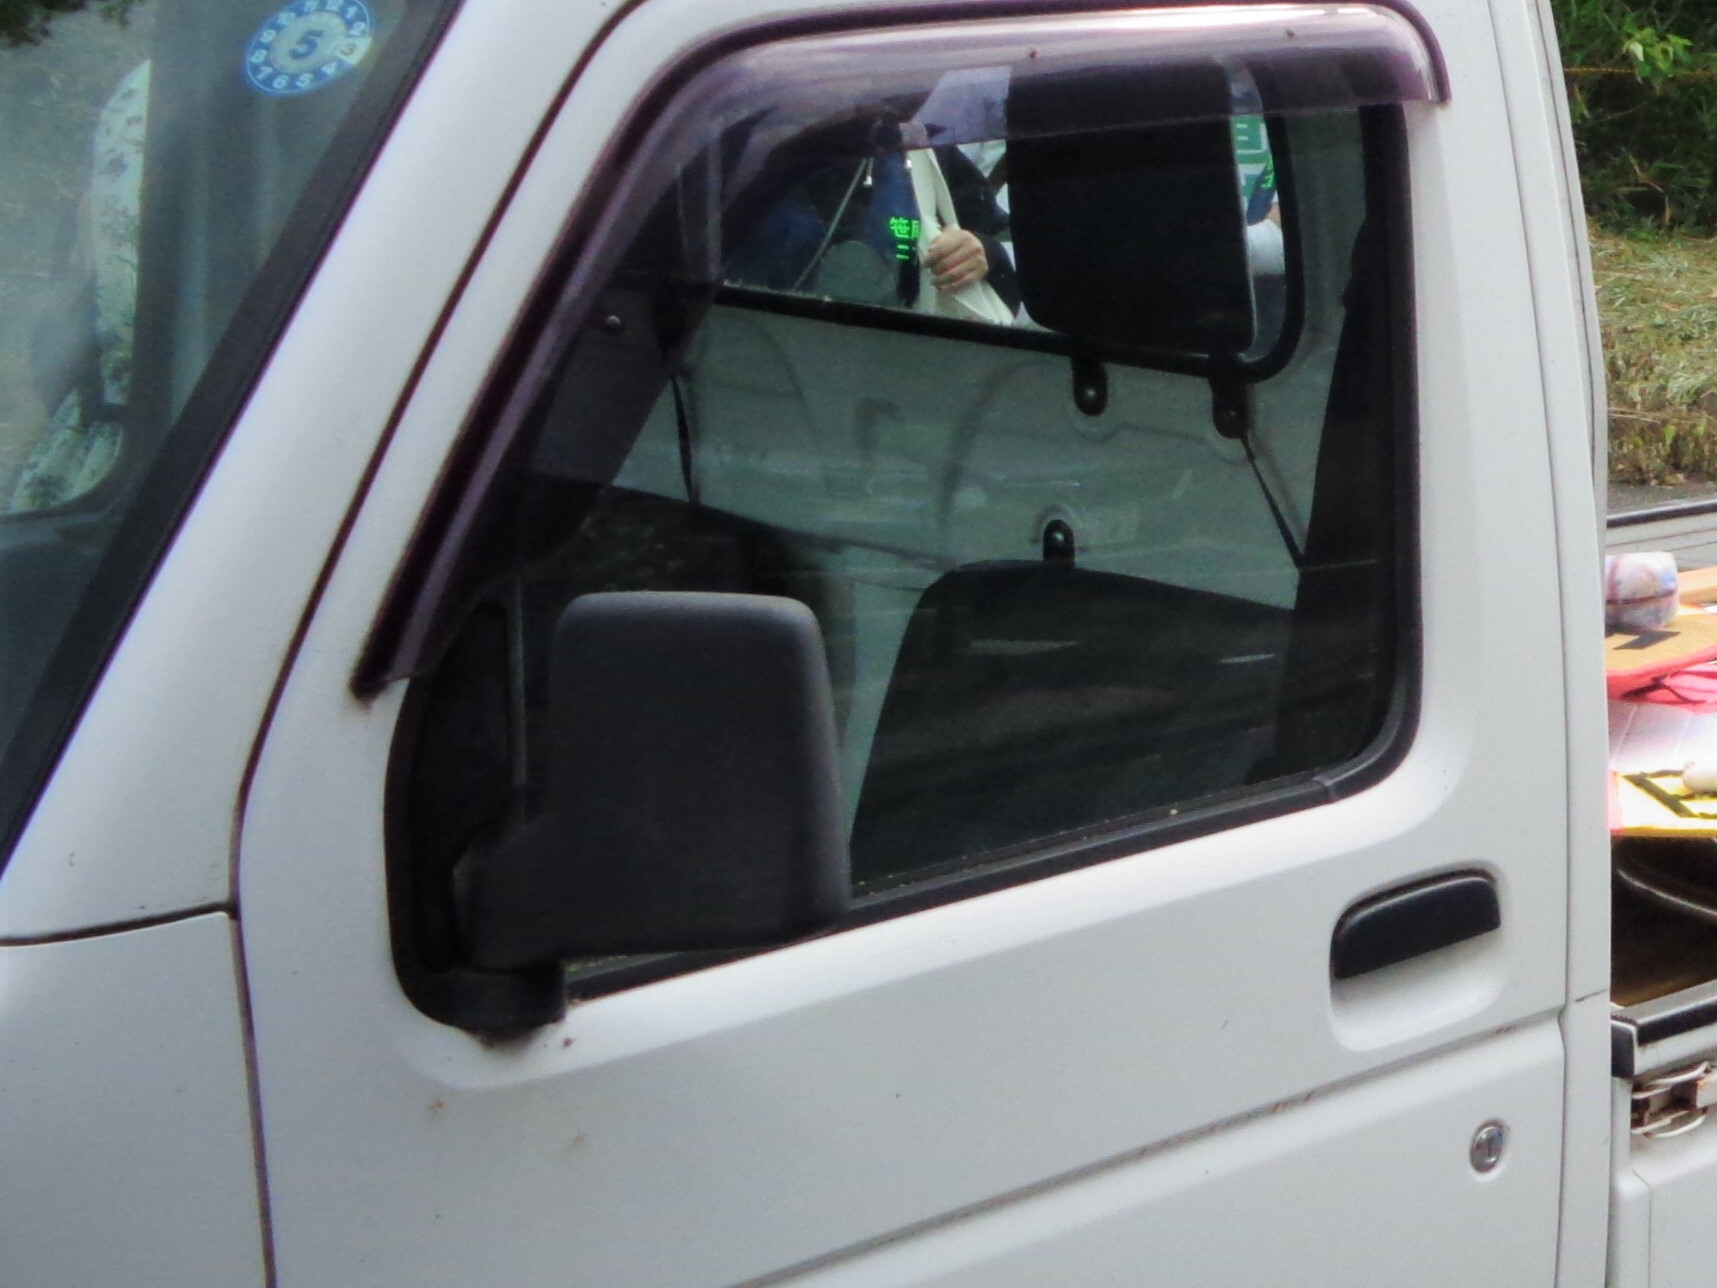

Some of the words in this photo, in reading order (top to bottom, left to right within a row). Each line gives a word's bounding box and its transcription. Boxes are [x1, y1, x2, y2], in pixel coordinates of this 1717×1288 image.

[346, 5, 357, 19] 1
[260, 28, 277, 43] 9
[348, 21, 366, 36] 2
[289, 29, 325, 60] 5
[341, 42, 357, 56] 3
[250, 49, 268, 64] 8
[257, 66, 272, 79] 7
[296, 73, 314, 87] 5
[273, 74, 289, 89] 6
